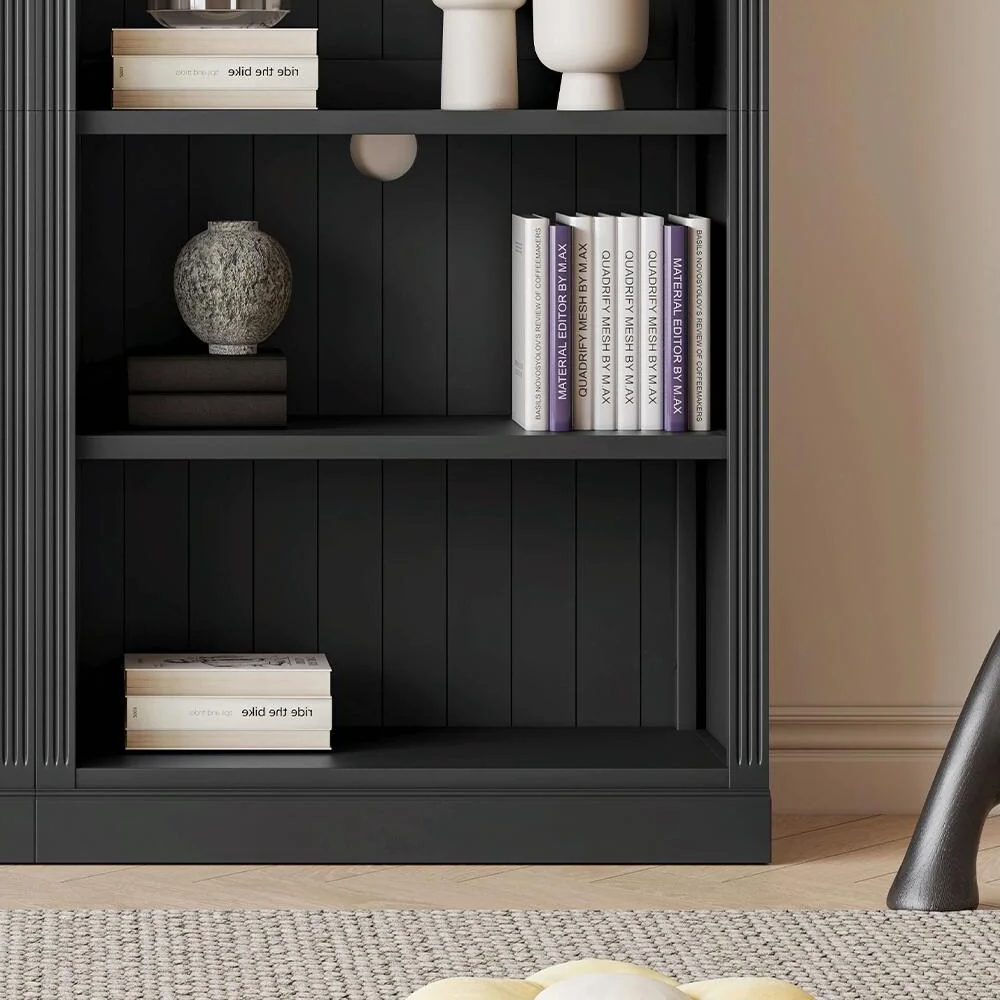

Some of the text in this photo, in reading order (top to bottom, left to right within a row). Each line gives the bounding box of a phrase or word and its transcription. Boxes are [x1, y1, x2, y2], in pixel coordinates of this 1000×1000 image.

[558, 243, 567, 400] MATERIAL EDITOR BY M.AX
[578, 243, 588, 398] QUADRIFY MESH BY M.AX
[601, 250, 611, 405] QUADRIFY MESH BY M.AX
[624, 250, 634, 405] QUADRIFY MESH BY M.AX
[648, 250, 658, 405] QUADRIFY MESH BY M.AX
[673, 257, 683, 414] MATERIAL EDITOR BY M.AX
[696, 349, 703, 360] OF
